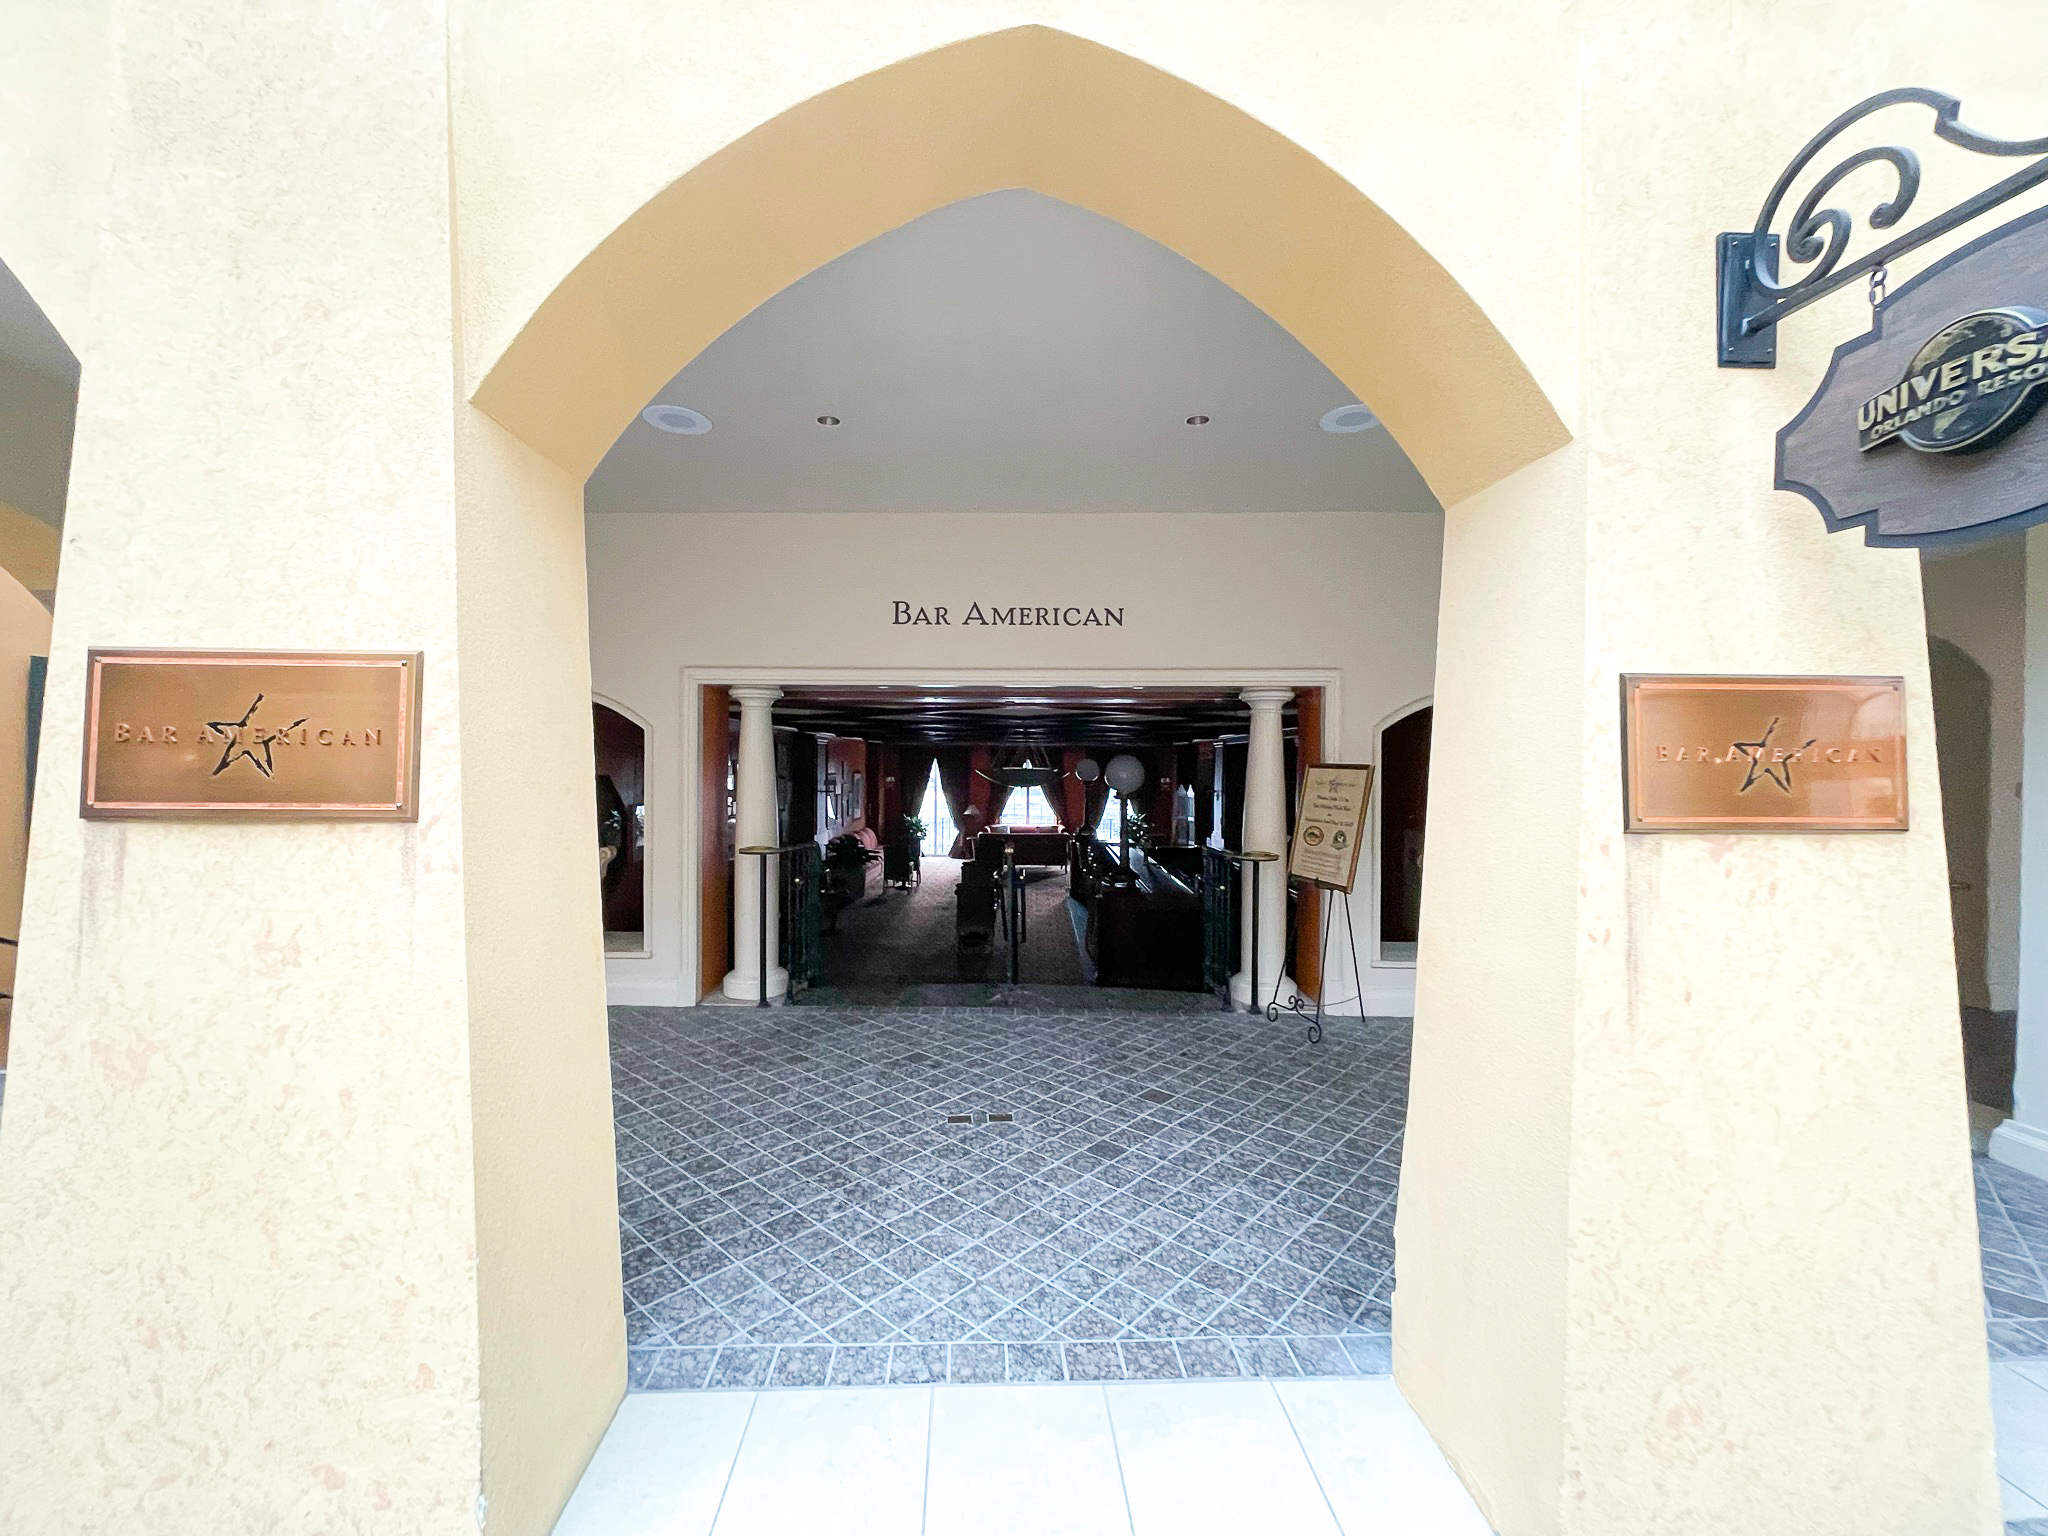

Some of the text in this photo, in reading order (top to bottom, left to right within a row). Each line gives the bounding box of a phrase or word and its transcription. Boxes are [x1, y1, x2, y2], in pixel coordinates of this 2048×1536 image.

[1870, 390, 1968, 439] ORLANDO
[113, 722, 382, 747] BAR AMERICAN
[1655, 746, 1882, 764] BAR AMERICAN
